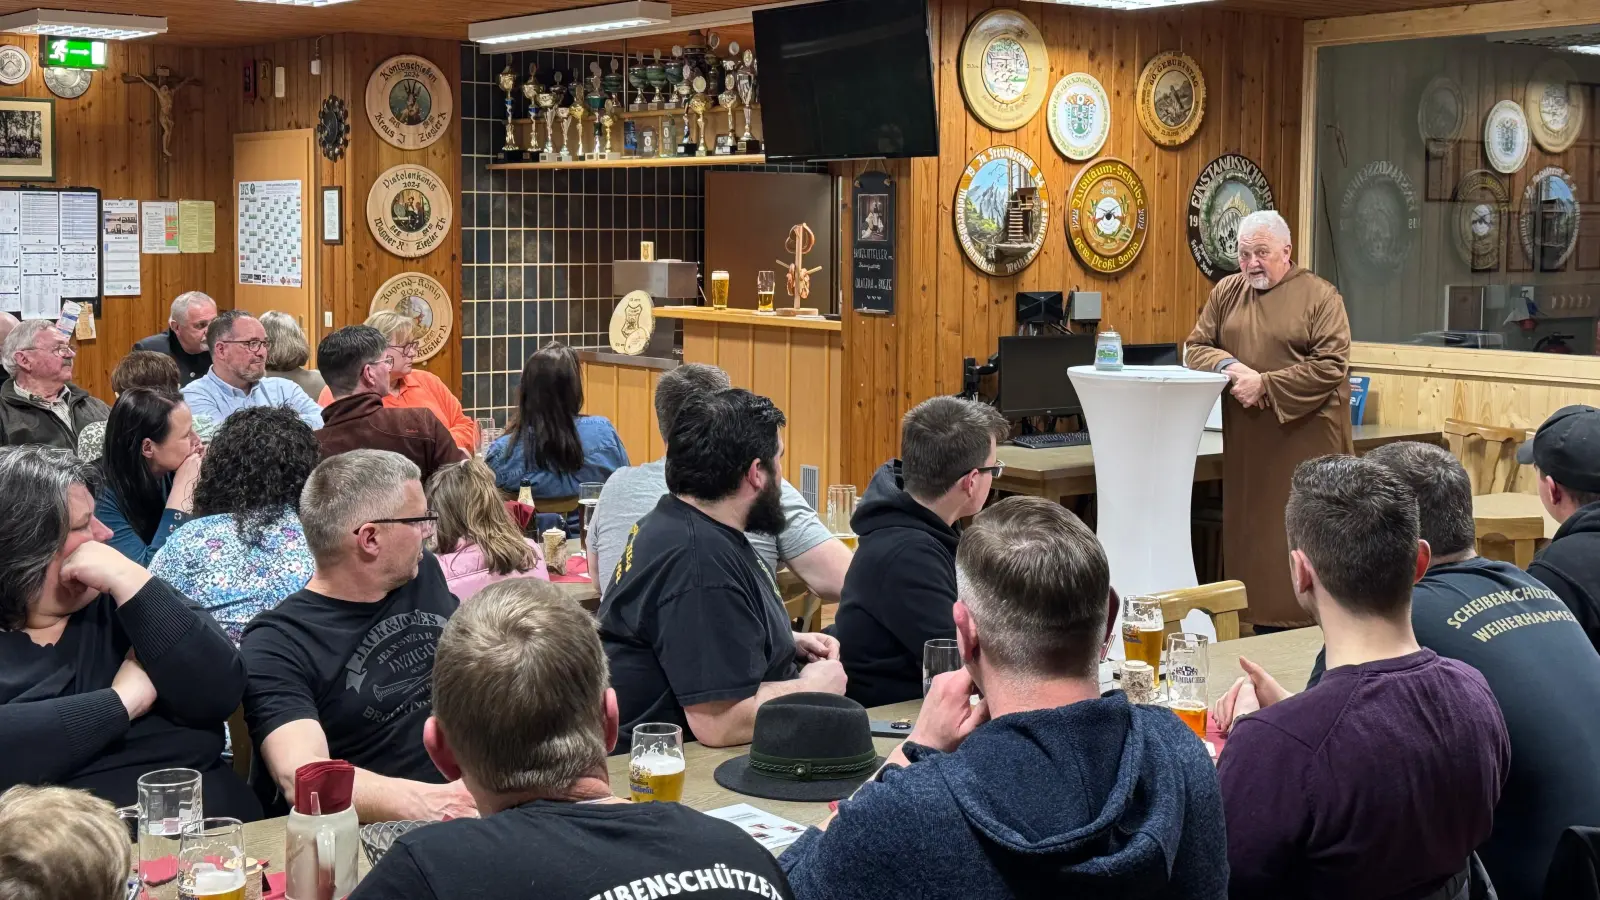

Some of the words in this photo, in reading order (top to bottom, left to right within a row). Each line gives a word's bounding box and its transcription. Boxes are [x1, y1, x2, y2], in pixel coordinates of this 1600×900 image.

[402, 181, 420, 189] 2024
[1072, 163, 1144, 208] Jubiläum-Scheibe
[1189, 215, 1199, 227] 19
[415, 232, 439, 251] Ziegler
[380, 278, 441, 304] Jugend-König
[400, 288, 425, 297] 2024
[357, 625, 386, 661] JACK
